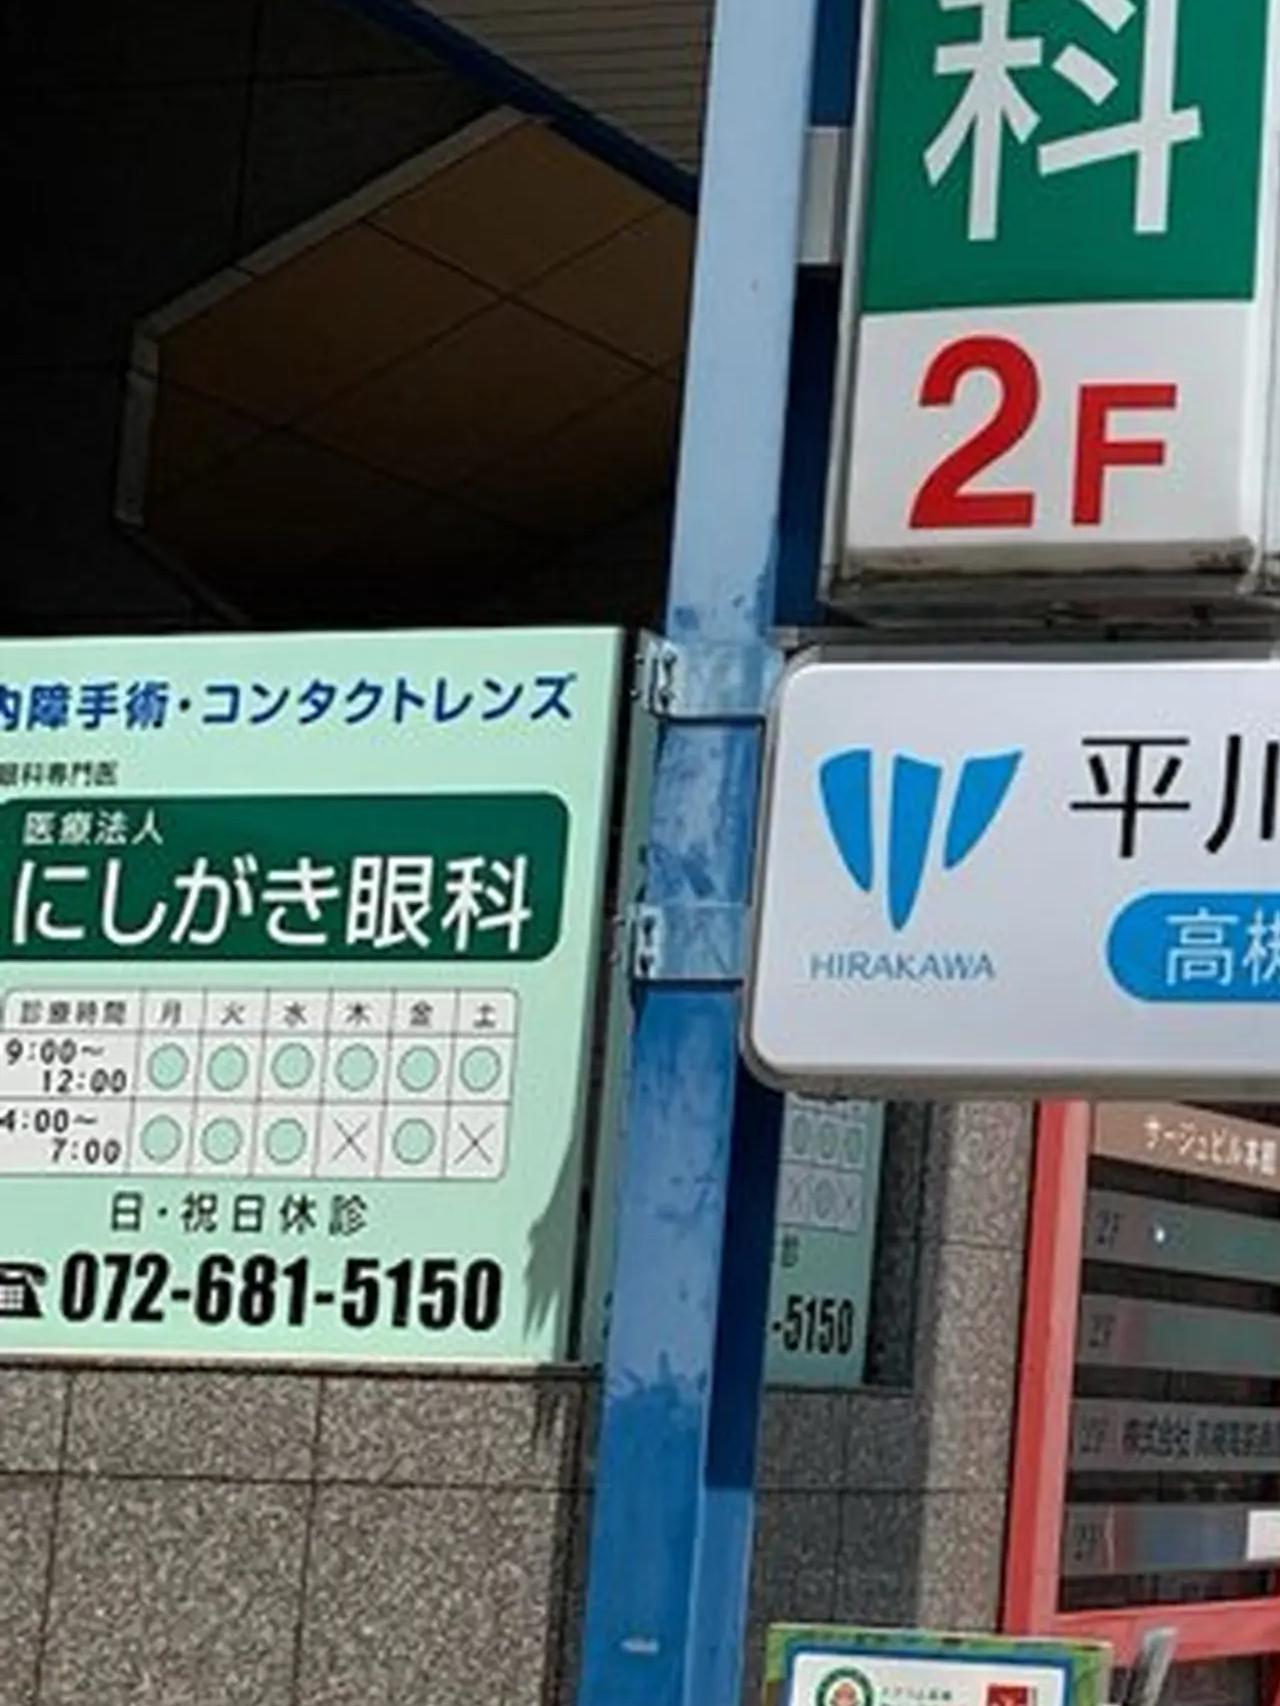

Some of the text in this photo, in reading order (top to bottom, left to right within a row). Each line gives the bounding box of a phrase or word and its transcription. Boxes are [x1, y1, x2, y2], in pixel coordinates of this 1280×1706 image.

[908, 334, 1179, 529] 2F
[22, 806, 164, 847] 医療法人
[12, 854, 532, 952] にしがき眼科
[809, 949, 997, 984] HIRAKAWA
[159, 999, 182, 1027] 月
[219, 1000, 247, 1027] 火
[282, 1001, 309, 1028] 水
[345, 1001, 373, 1027] 木
[408, 1000, 434, 1028] 金
[472, 1003, 497, 1029] 土
[42, 1068, 128, 1094] 12:00
[51, 1137, 122, 1165] 7:00
[110, 1192, 370, 1237] 日・祝日休診
[60, 1250, 503, 1332] 072-681-5150
